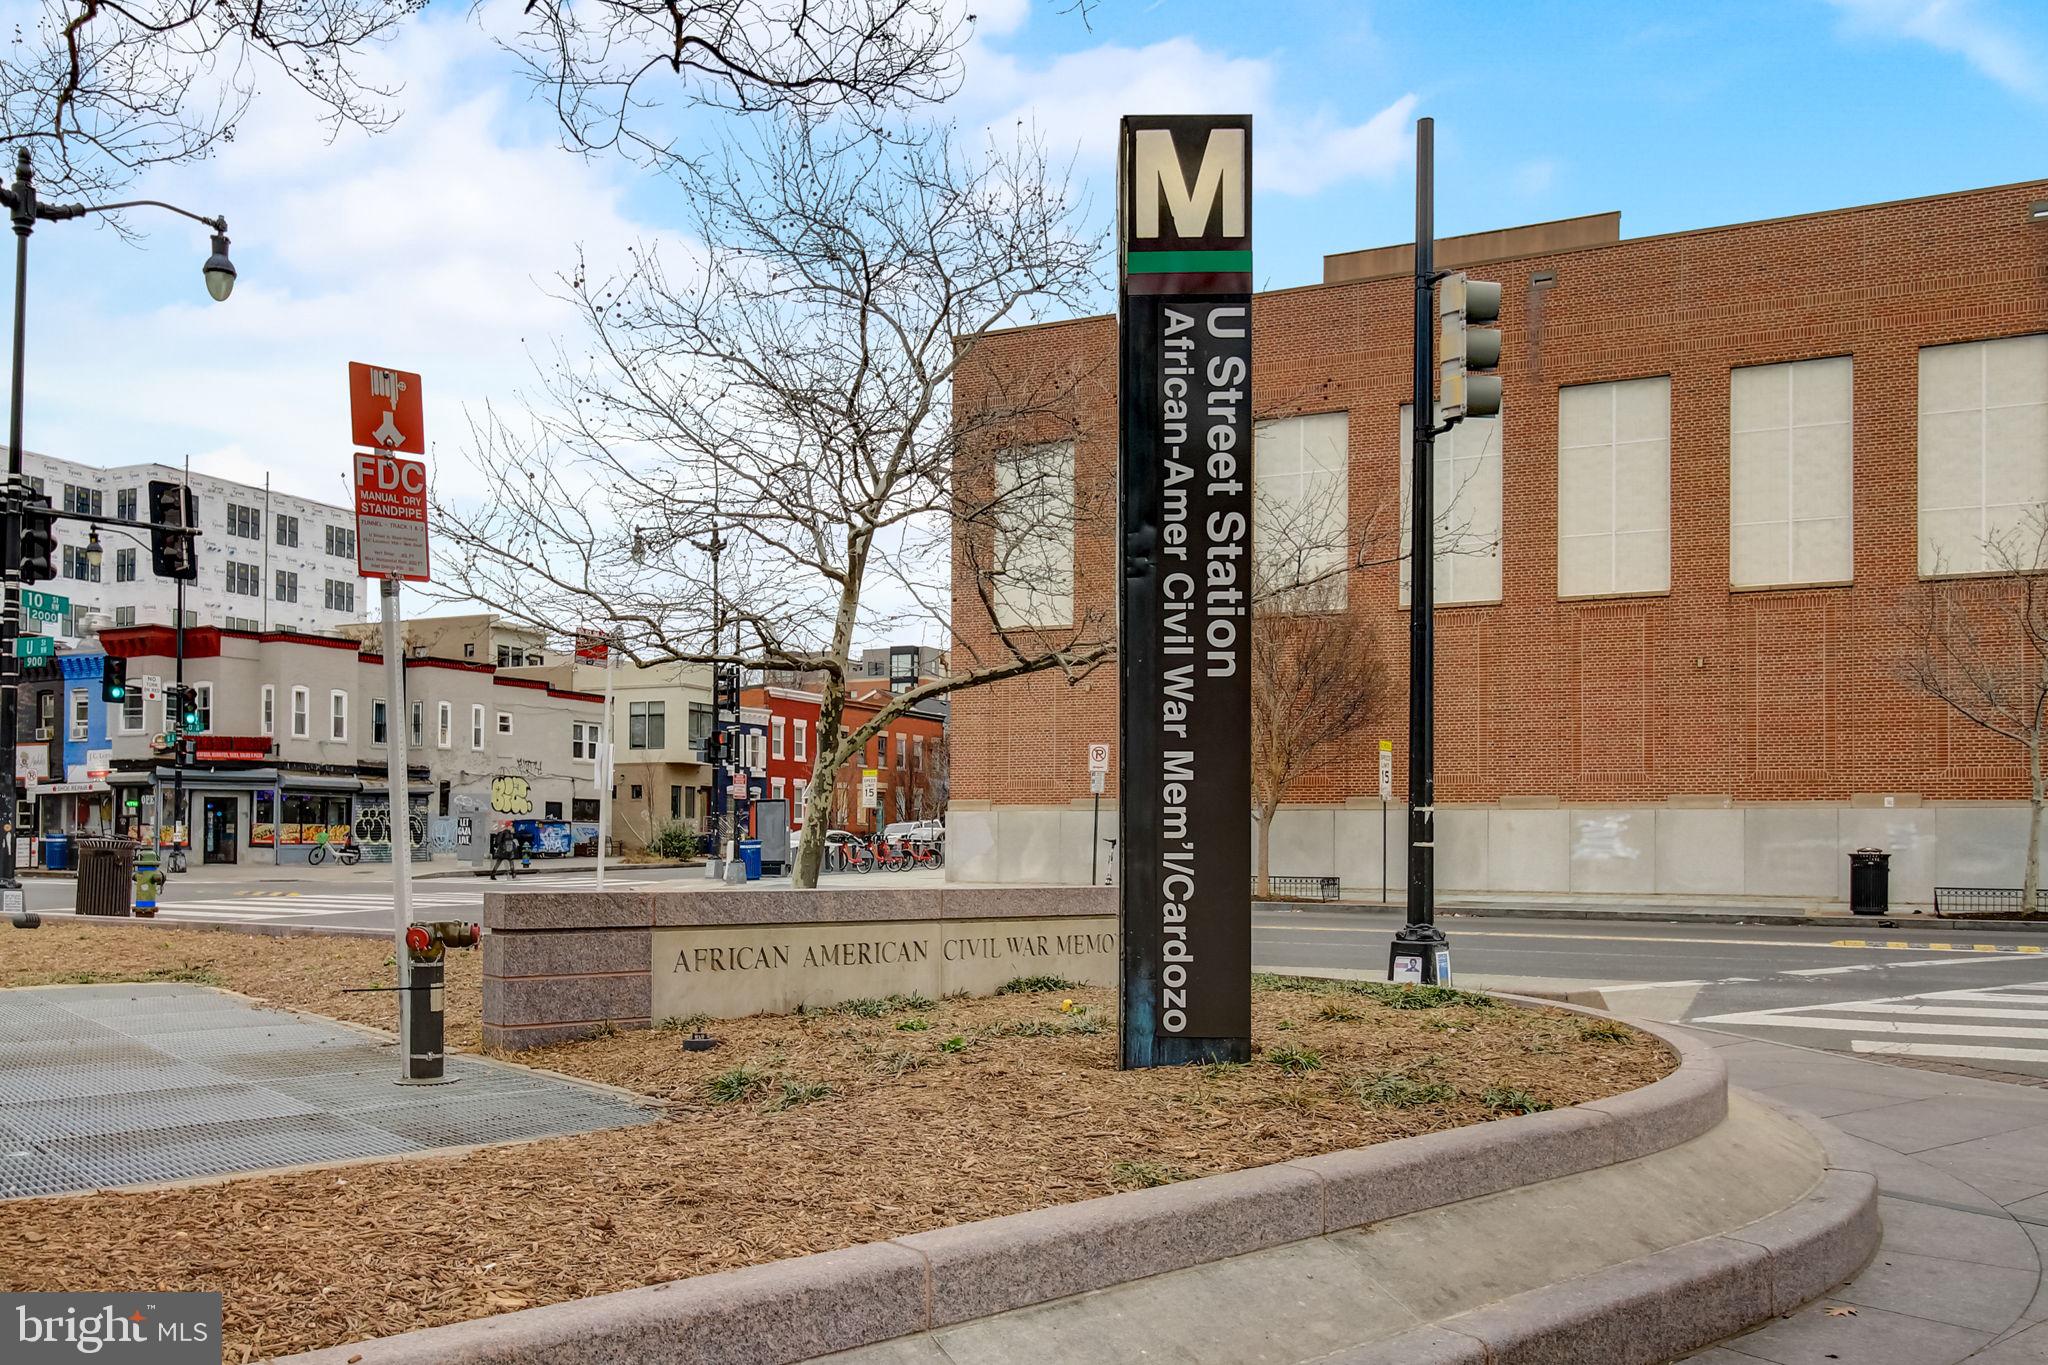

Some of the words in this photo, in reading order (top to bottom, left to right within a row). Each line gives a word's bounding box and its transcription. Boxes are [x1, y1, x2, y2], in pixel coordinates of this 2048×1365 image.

[1136, 129, 1246, 239] M
[1206, 307, 1246, 338] U
[1163, 308, 1195, 561] African-Amer
[1206, 356, 1246, 496] Street
[356, 456, 425, 494] FDC
[360, 490, 400, 504] MANUAL
[403, 495, 422, 506] DRY
[361, 502, 423, 519] STANDPIPE
[28, 592, 43, 608] 10
[1206, 511, 1246, 677] Station
[32, 609, 57, 621] 2000
[1163, 573, 1195, 655] Civil
[26, 640, 34, 655] U
[27, 656, 43, 667] 900
[1163, 664, 1195, 739] War
[1381, 770, 1390, 784] 15
[141, 795, 155, 804] OPE
[865, 788, 875, 797] 15
[460, 818, 470, 827] LET
[458, 827, 471, 836] GAZA
[1163, 751, 1195, 1034] Mem'l/Cardozo
[673, 944, 790, 974] AFRICAN
[803, 939, 929, 968] AMERICAN
[943, 937, 1002, 962] CIVIL
[1006, 935, 1049, 958] WAR
[1056, 932, 1118, 956] MEMO
